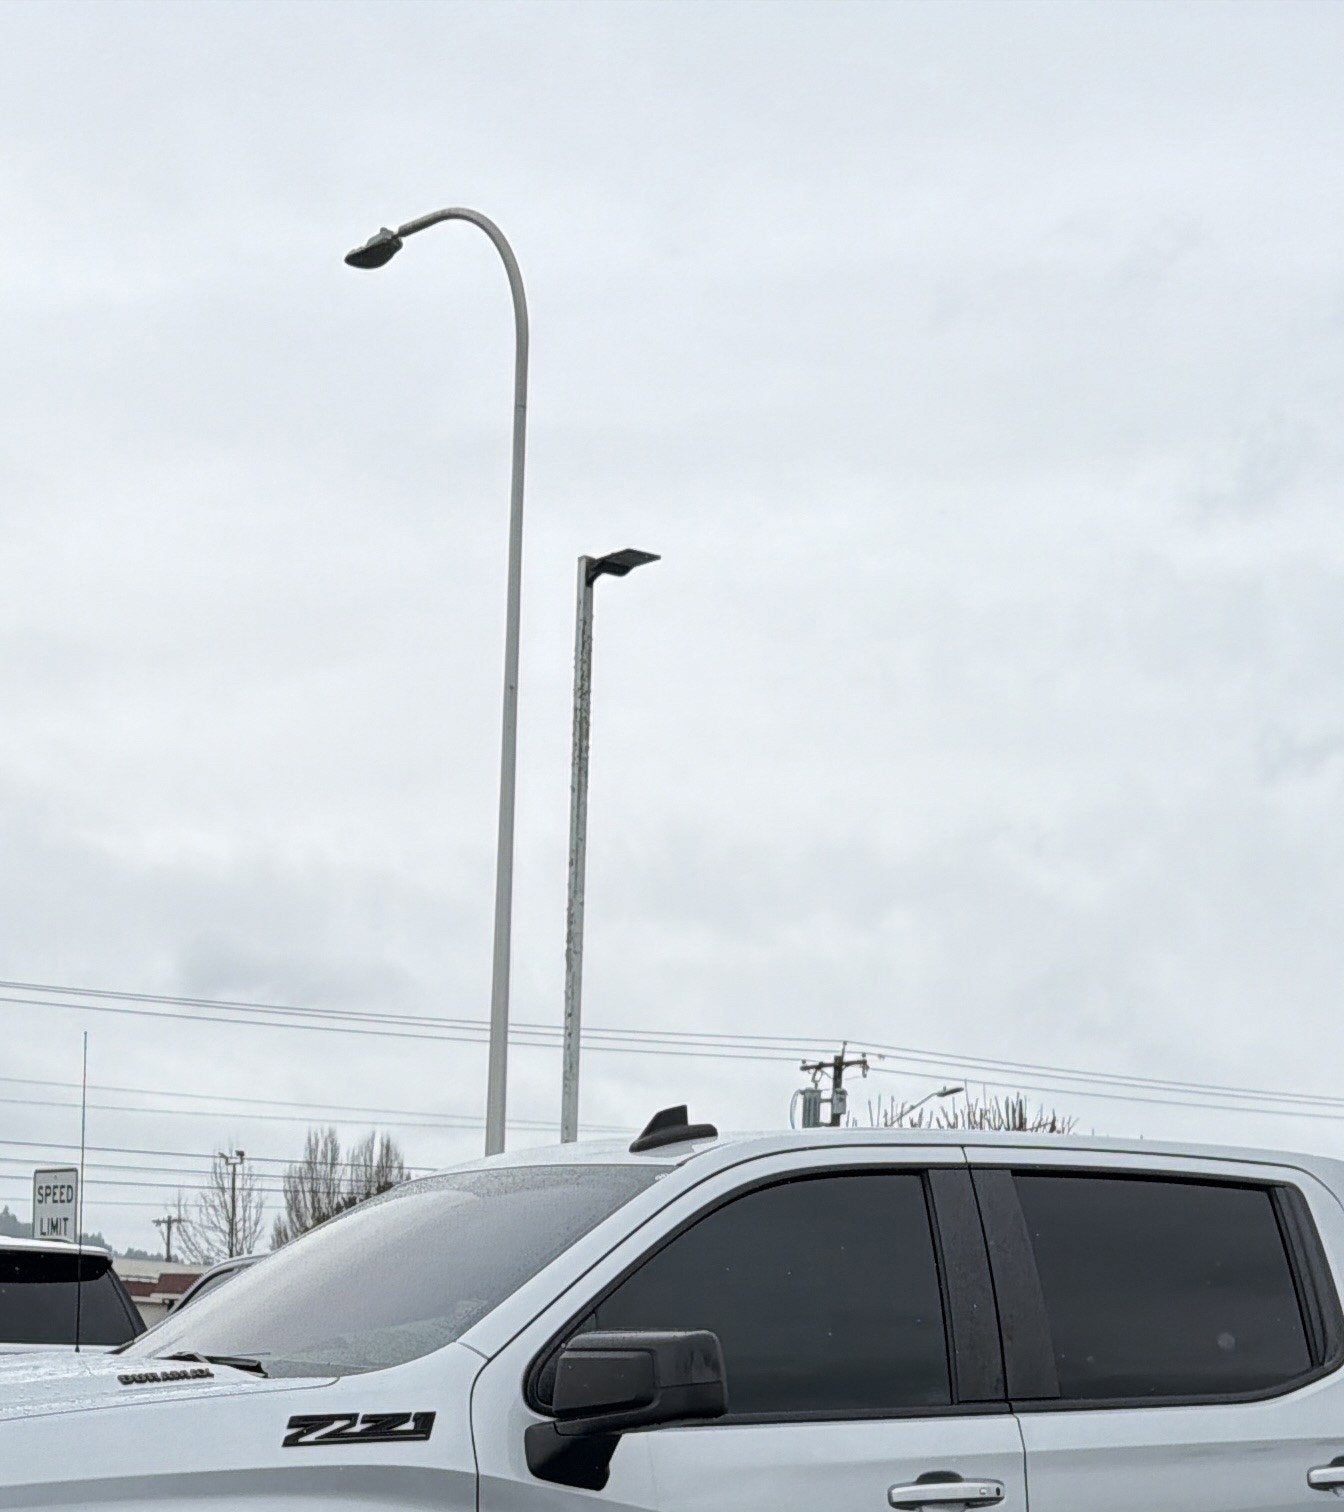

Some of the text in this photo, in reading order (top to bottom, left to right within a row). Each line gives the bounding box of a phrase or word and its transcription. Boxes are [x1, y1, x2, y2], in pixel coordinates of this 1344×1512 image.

[37, 1185, 73, 1204] SPEED
[40, 1217, 69, 1236] LIMIT
[282, 1411, 436, 1447] Z71
